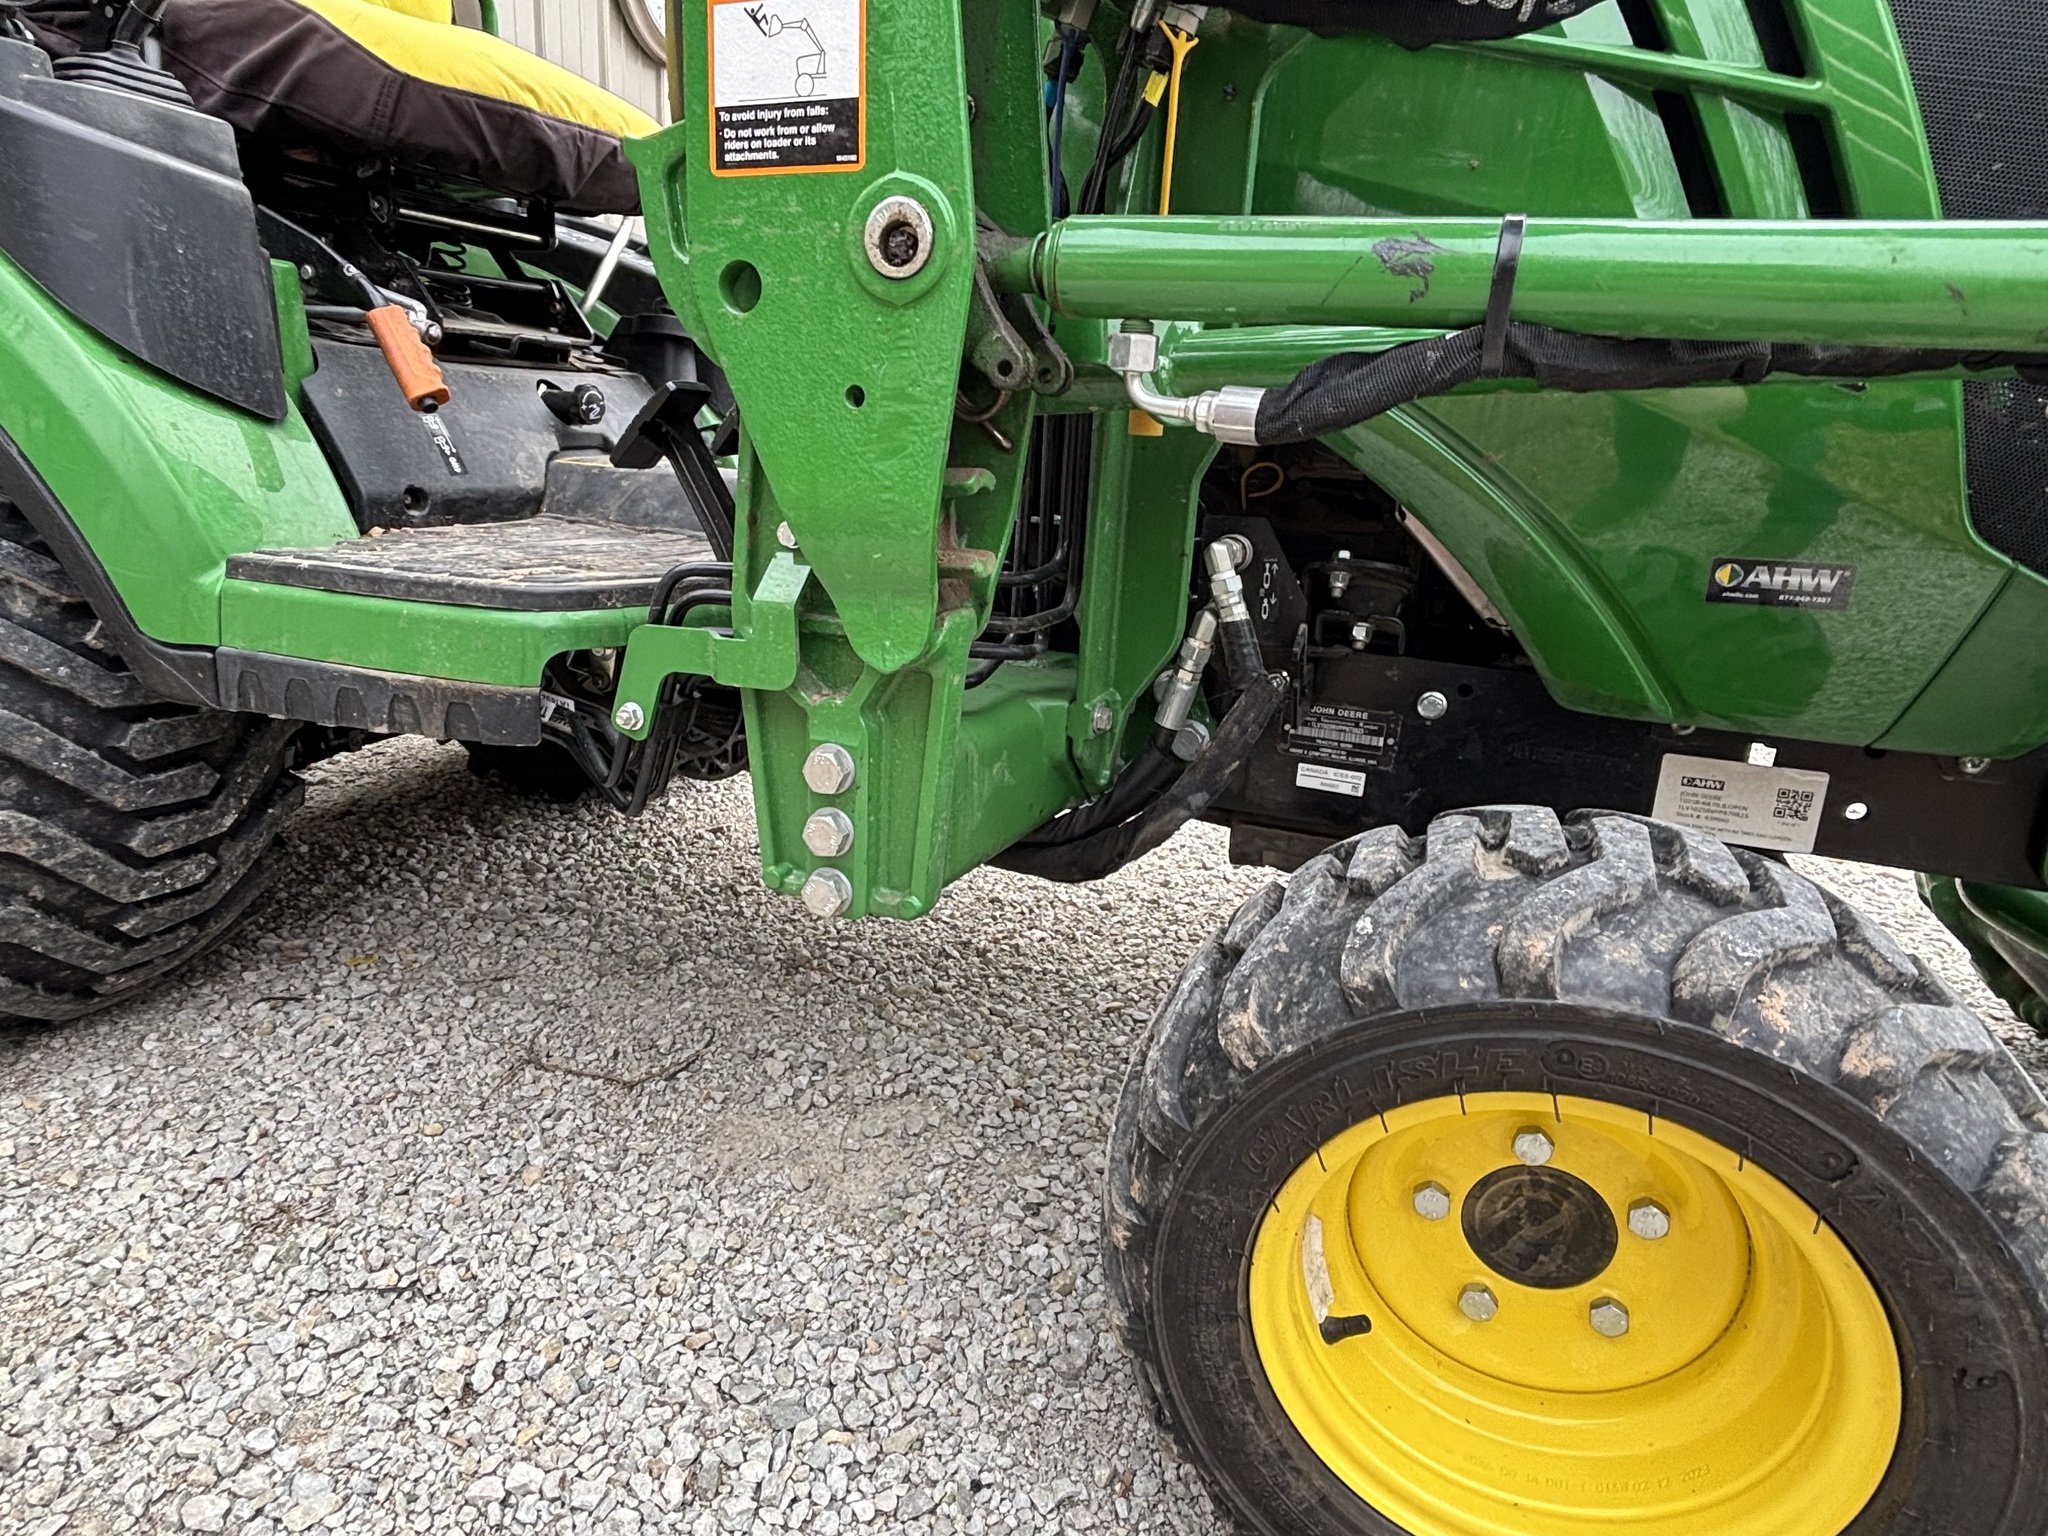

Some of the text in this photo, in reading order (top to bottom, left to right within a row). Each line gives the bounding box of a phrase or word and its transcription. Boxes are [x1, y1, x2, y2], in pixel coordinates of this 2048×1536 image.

[719, 105, 829, 122] To avoid injury from falls:
[723, 122, 836, 138] Do not work from or allow
[724, 135, 817, 150] riders on loader or its
[724, 149, 780, 162] attachments.
[1741, 565, 1844, 593] AHW
[1310, 705, 1369, 720] JOHN DEERE
[1300, 765, 1329, 776] CANADA
[1691, 778, 1724, 790] AHW
